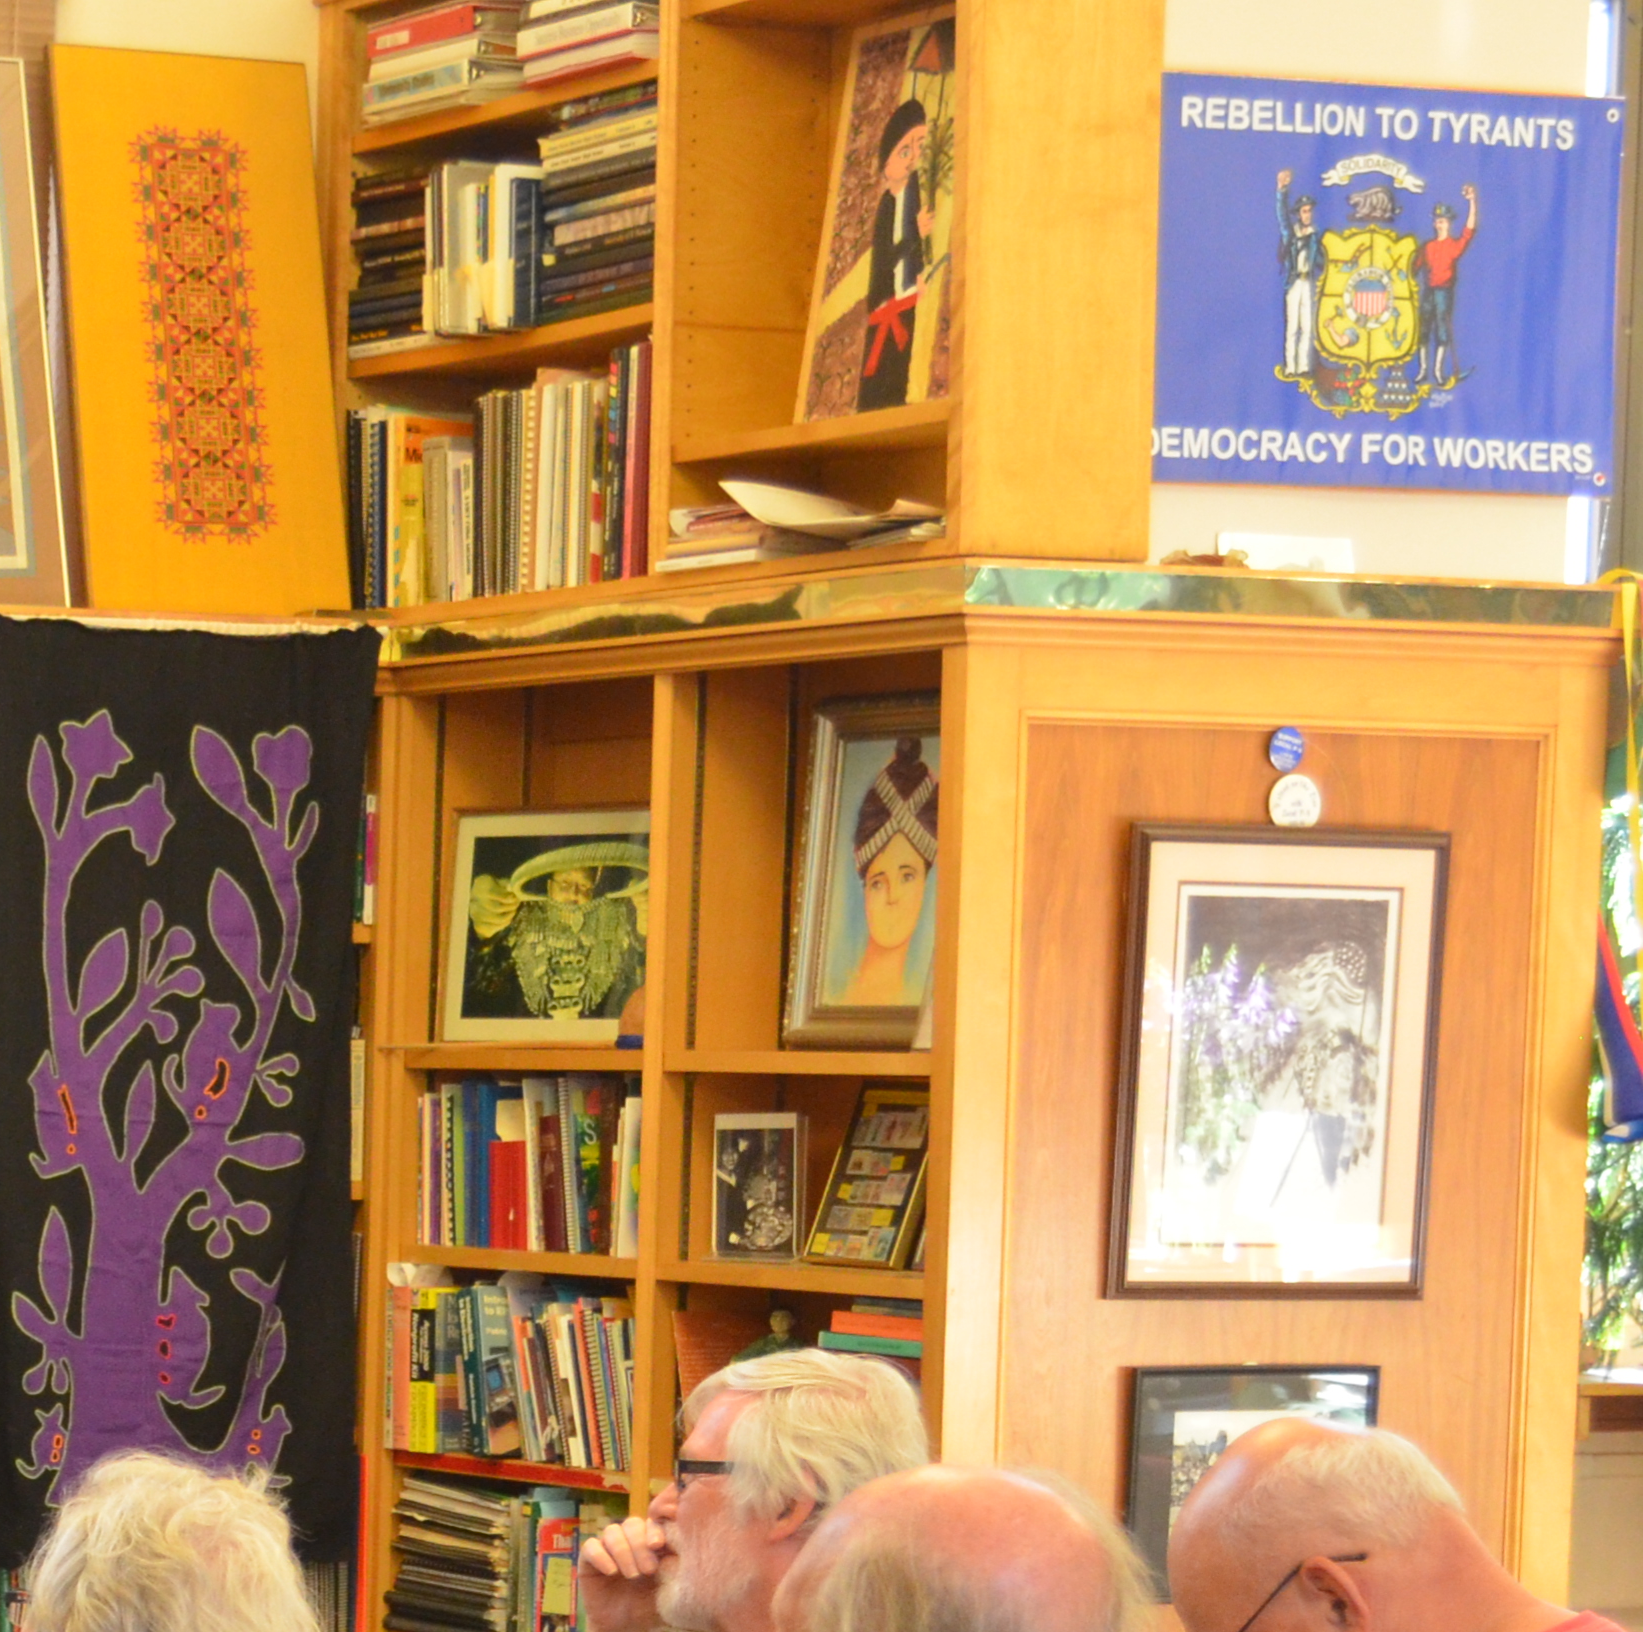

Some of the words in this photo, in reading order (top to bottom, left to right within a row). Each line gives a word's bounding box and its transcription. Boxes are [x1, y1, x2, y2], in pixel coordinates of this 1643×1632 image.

[1181, 97, 1365, 138] REBELLION
[1376, 107, 1418, 141] TO
[1427, 111, 1575, 150] TYRANTS
[1340, 158, 1401, 175] SOLIDARITY
[1361, 432, 1425, 466] FOR
[1434, 436, 1593, 474] WORKERS
[465, 1296, 474, 1352] Introduction
